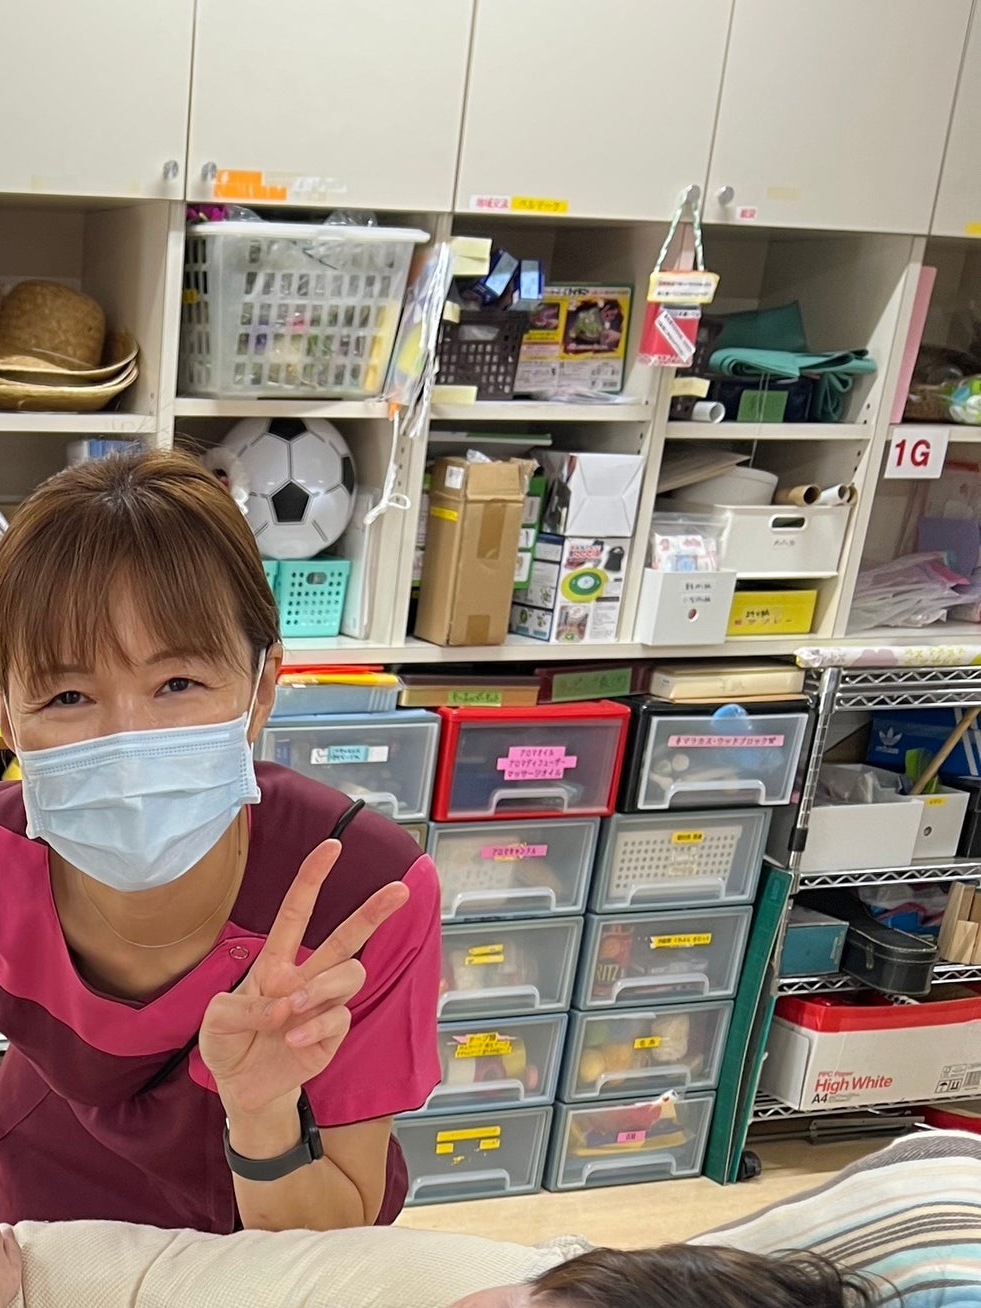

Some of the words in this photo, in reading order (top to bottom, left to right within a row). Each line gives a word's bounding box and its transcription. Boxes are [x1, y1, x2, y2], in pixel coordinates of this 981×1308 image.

[895, 439, 931, 467] 1G
[815, 1079, 849, 1094] High
[852, 1075, 893, 1090] White
[812, 1093, 828, 1104] A4
